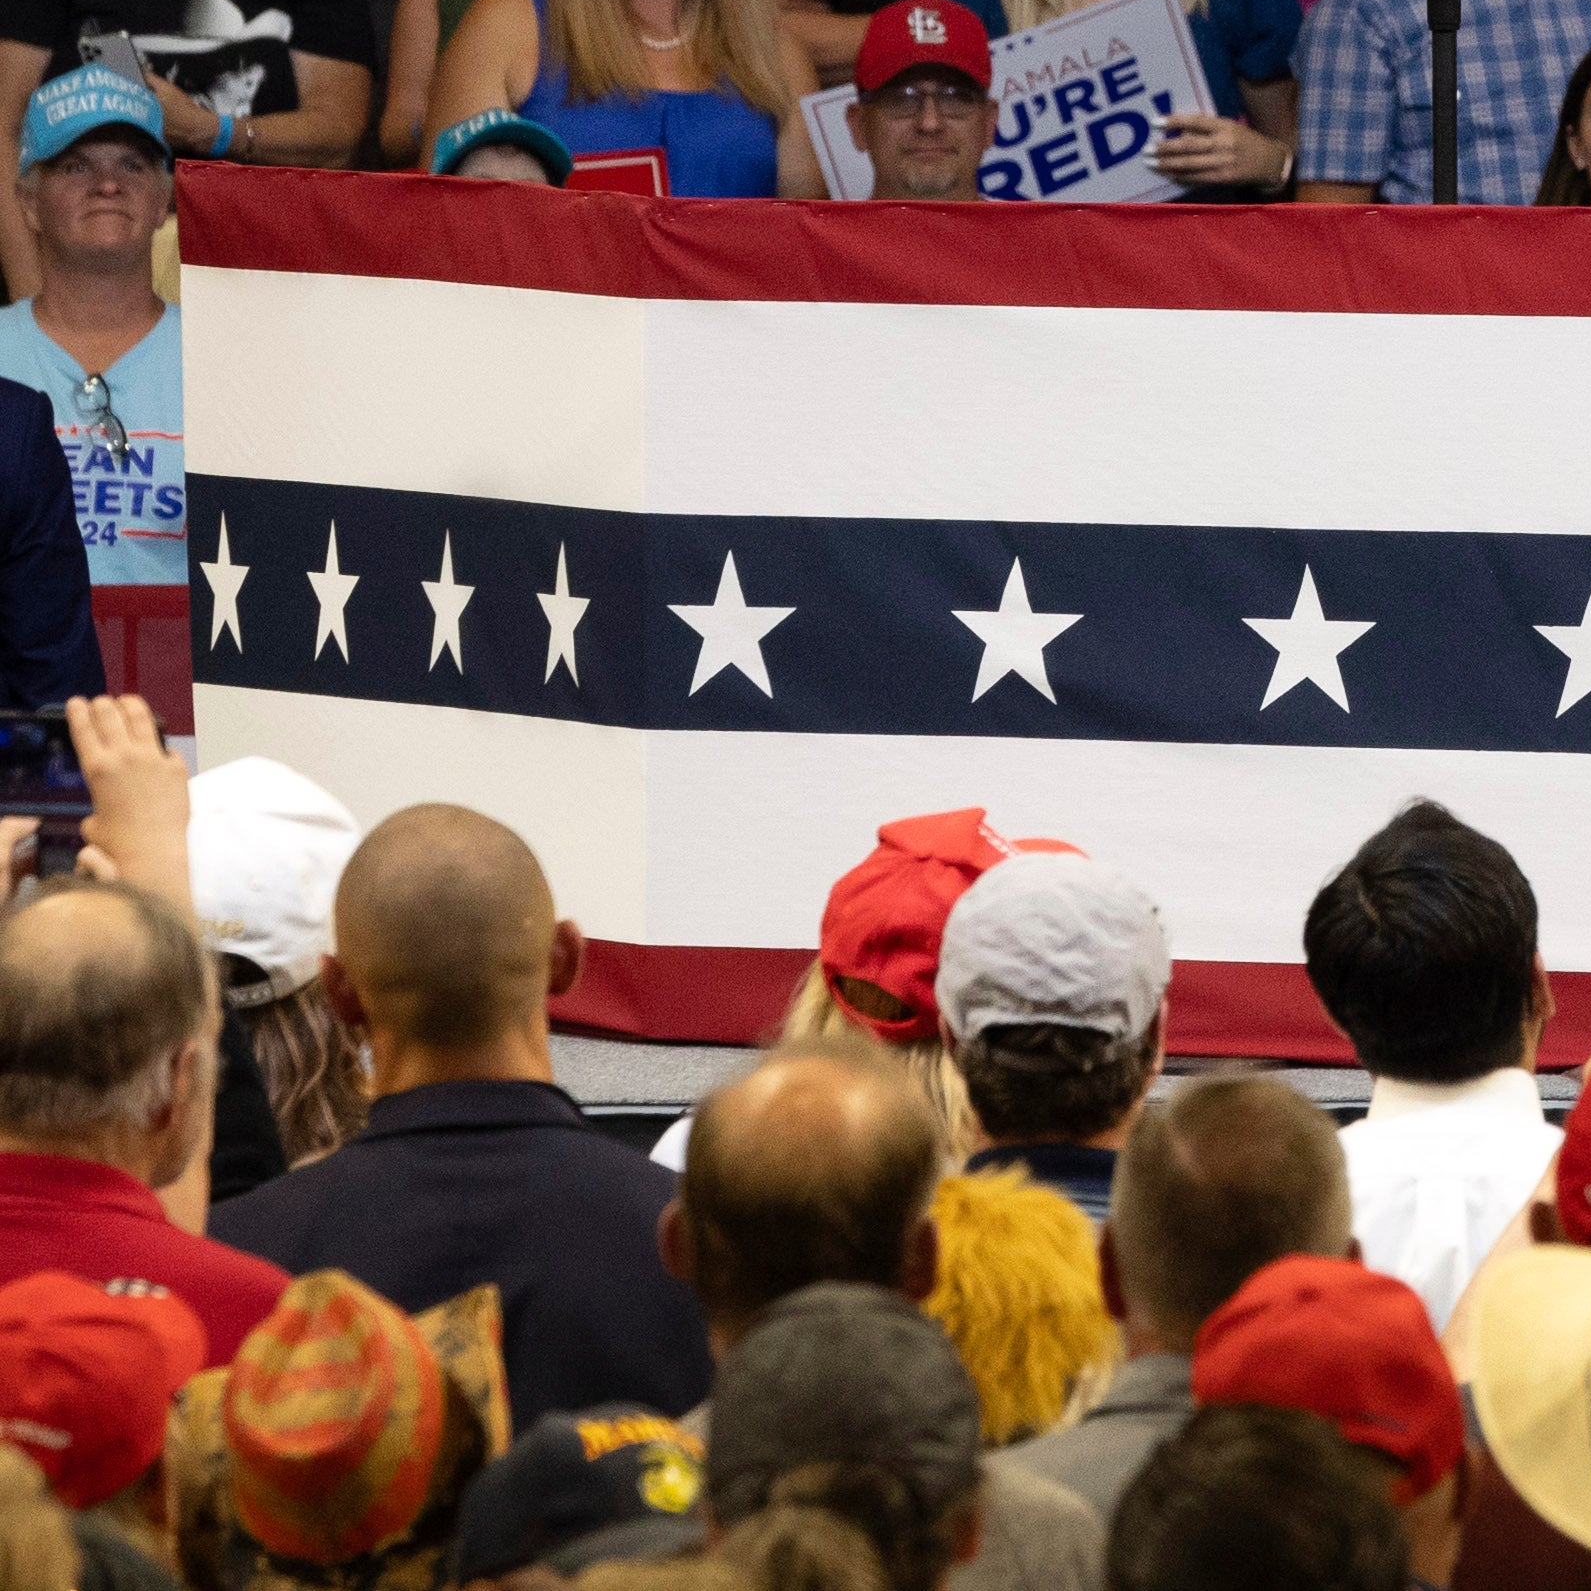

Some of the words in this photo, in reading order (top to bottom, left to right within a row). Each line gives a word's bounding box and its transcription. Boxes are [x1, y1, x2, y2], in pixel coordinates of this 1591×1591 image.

[36, 75, 83, 105] MAKE
[83, 67, 151, 102] AMERICA
[1003, 37, 1135, 101] AMALA
[45, 93, 96, 127] GREAT
[102, 94, 150, 123] AGAIN
[993, 54, 1147, 149] U'RE
[978, 89, 1177, 202] RED!
[63, 444, 155, 477] EAN
[71, 478, 184, 521] EETS
